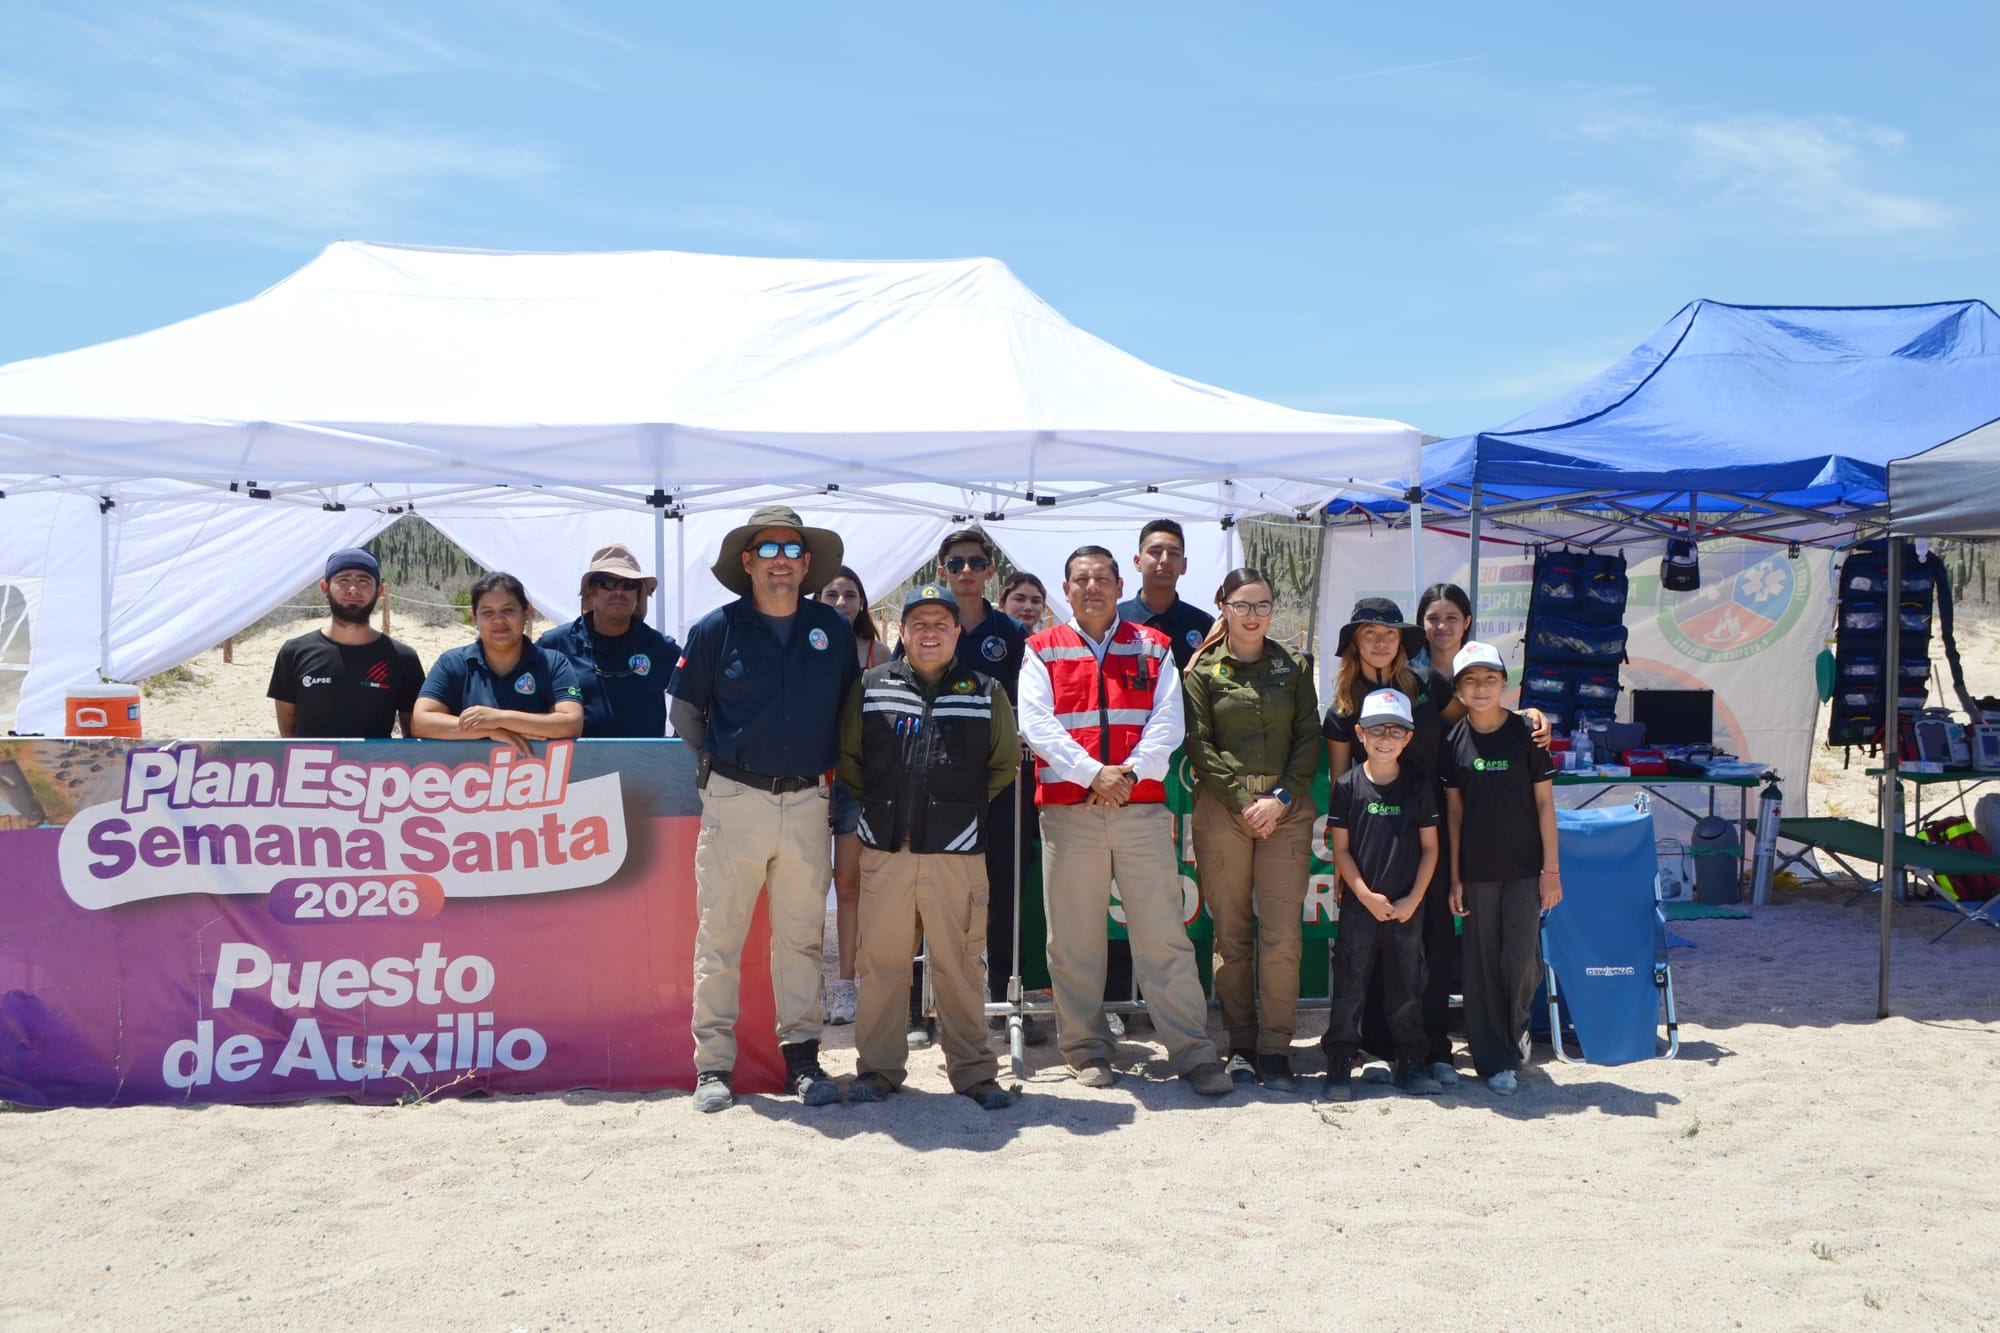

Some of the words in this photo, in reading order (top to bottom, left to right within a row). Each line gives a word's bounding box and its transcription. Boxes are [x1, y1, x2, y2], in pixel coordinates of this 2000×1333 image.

[302, 675, 332, 687] CAPSE
[125, 747, 277, 811] Plan
[281, 743, 569, 820] Especial
[1473, 758, 1508, 771] CAPSE
[87, 817, 388, 881] Semana
[400, 812, 610, 874] Santa
[293, 879, 420, 919] 2026
[211, 942, 496, 1009] Puesto
[162, 1019, 264, 1089] de
[271, 1011, 548, 1082] Auxilio
